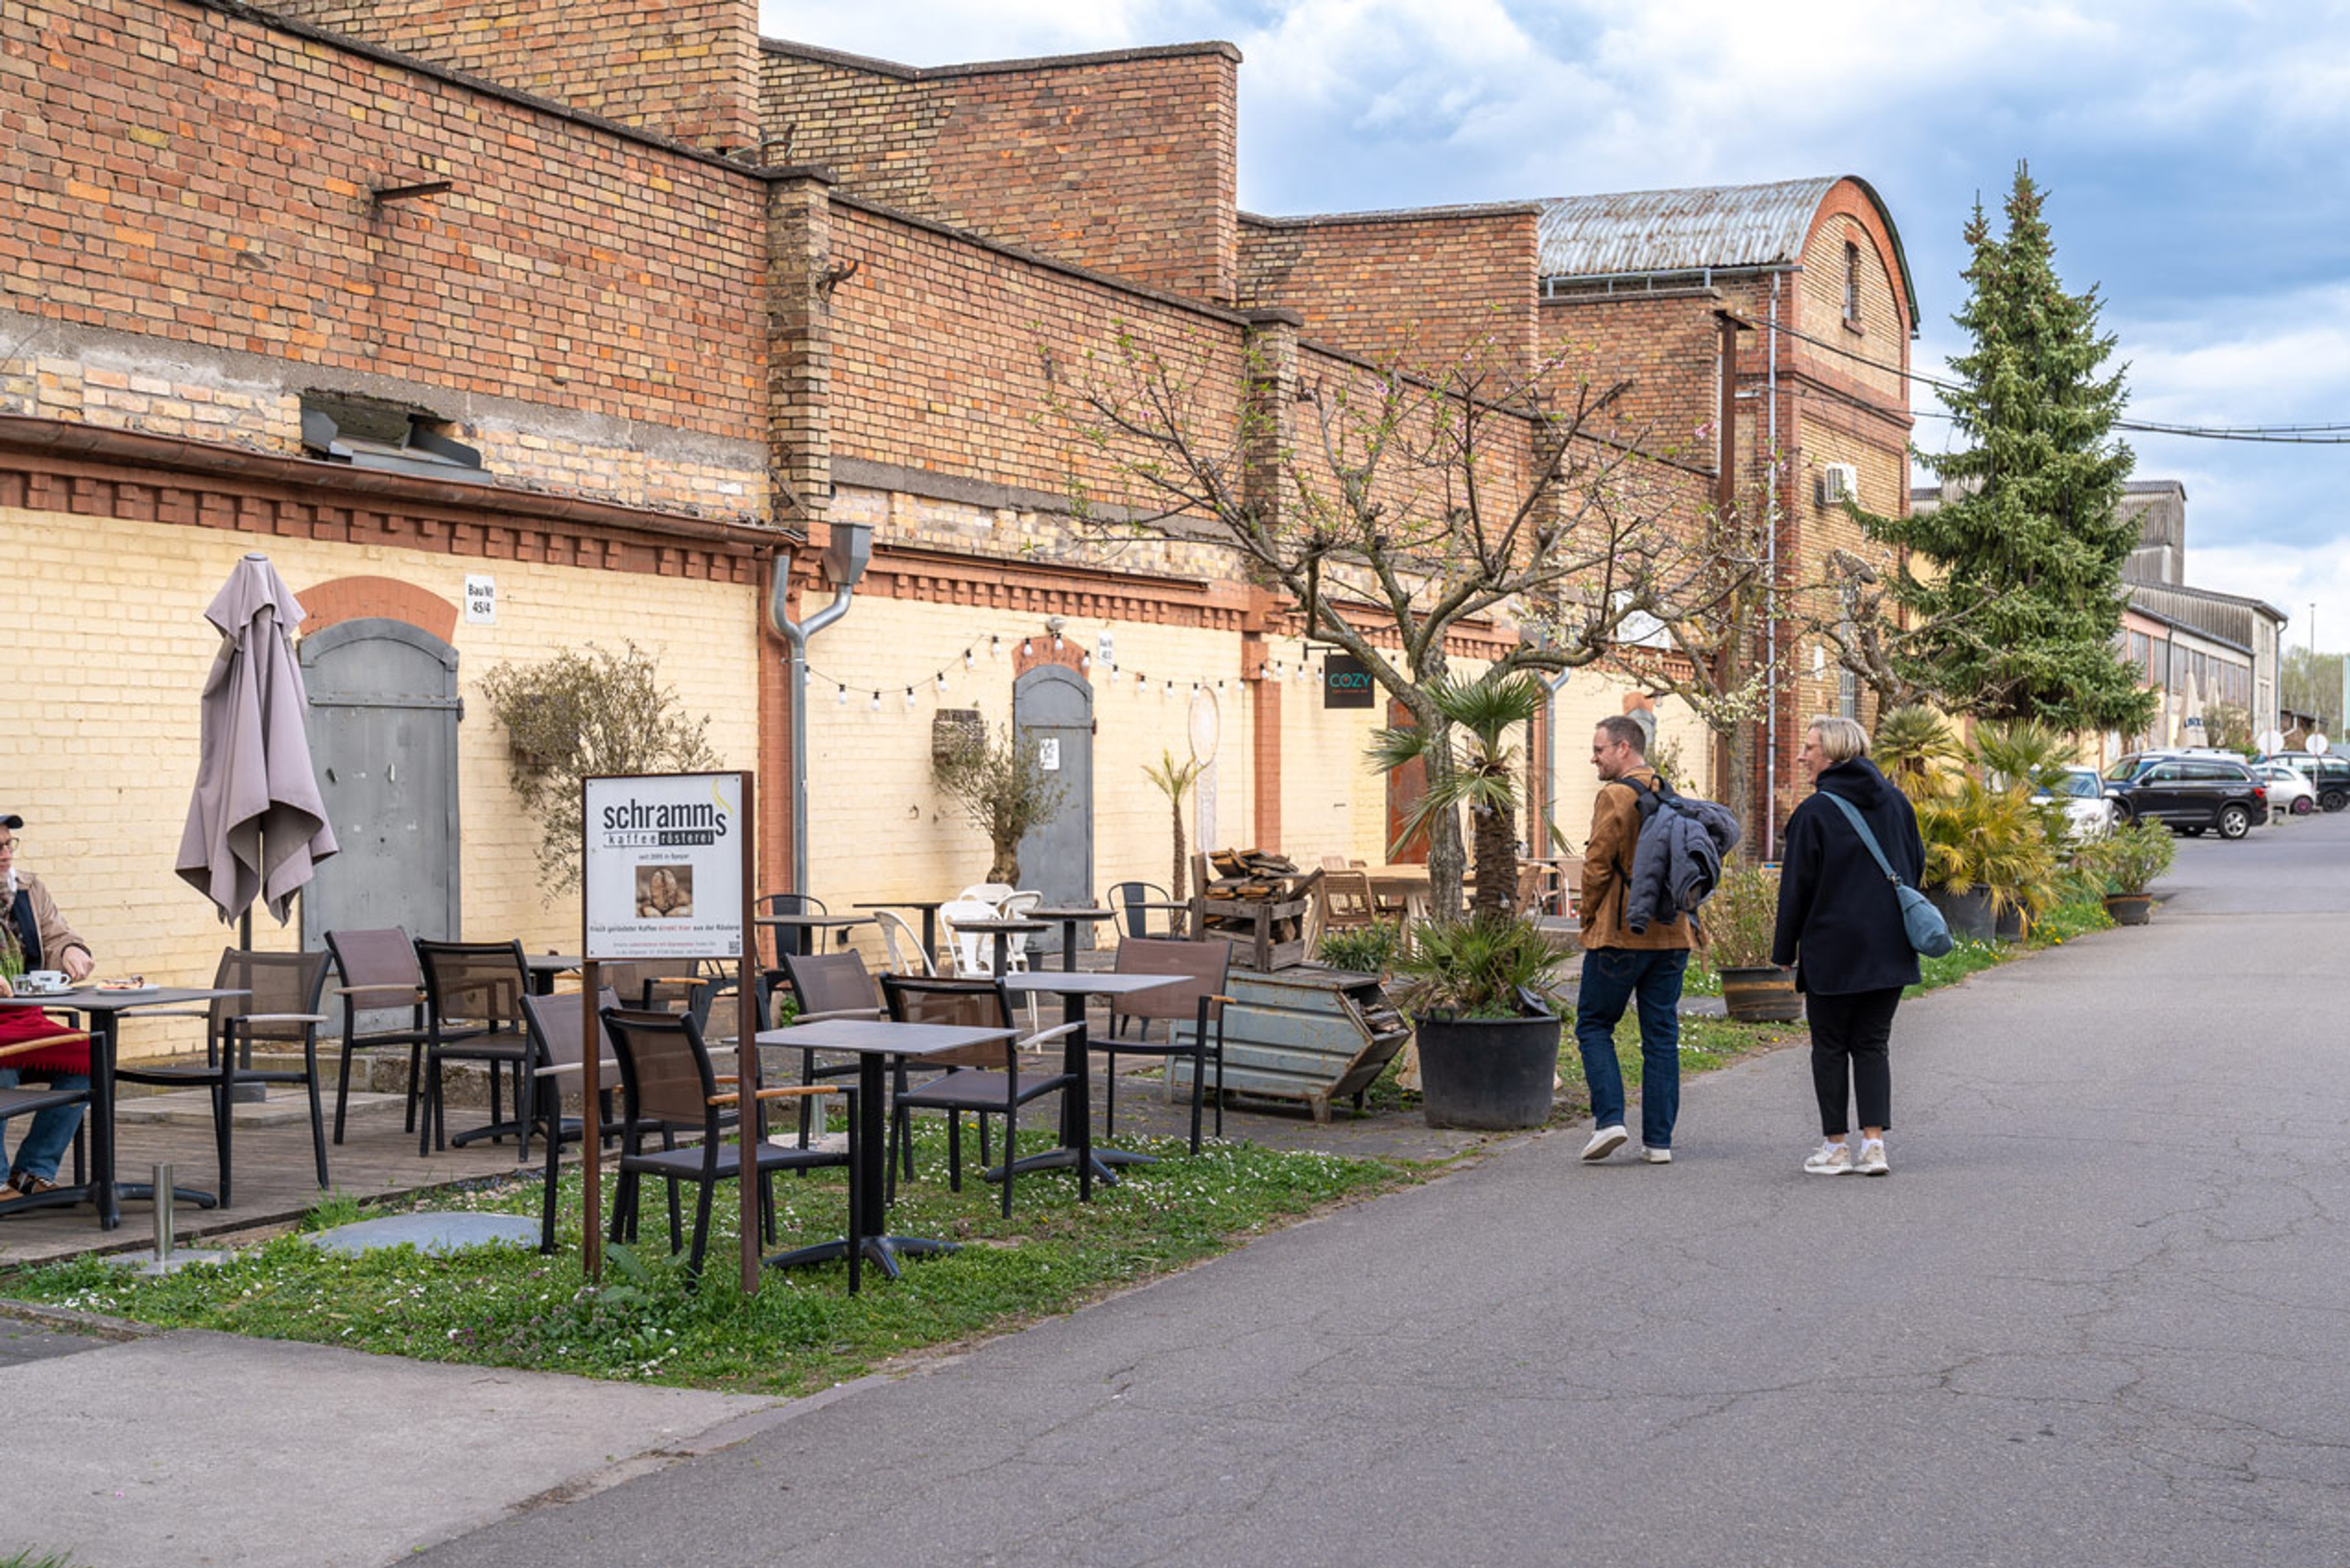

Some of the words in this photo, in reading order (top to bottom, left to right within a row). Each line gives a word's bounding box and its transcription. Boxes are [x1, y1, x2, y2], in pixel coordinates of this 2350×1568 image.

[468, 583, 483, 597] Bau
[1329, 673, 1371, 687] COZY
[603, 799, 727, 837] schramms
